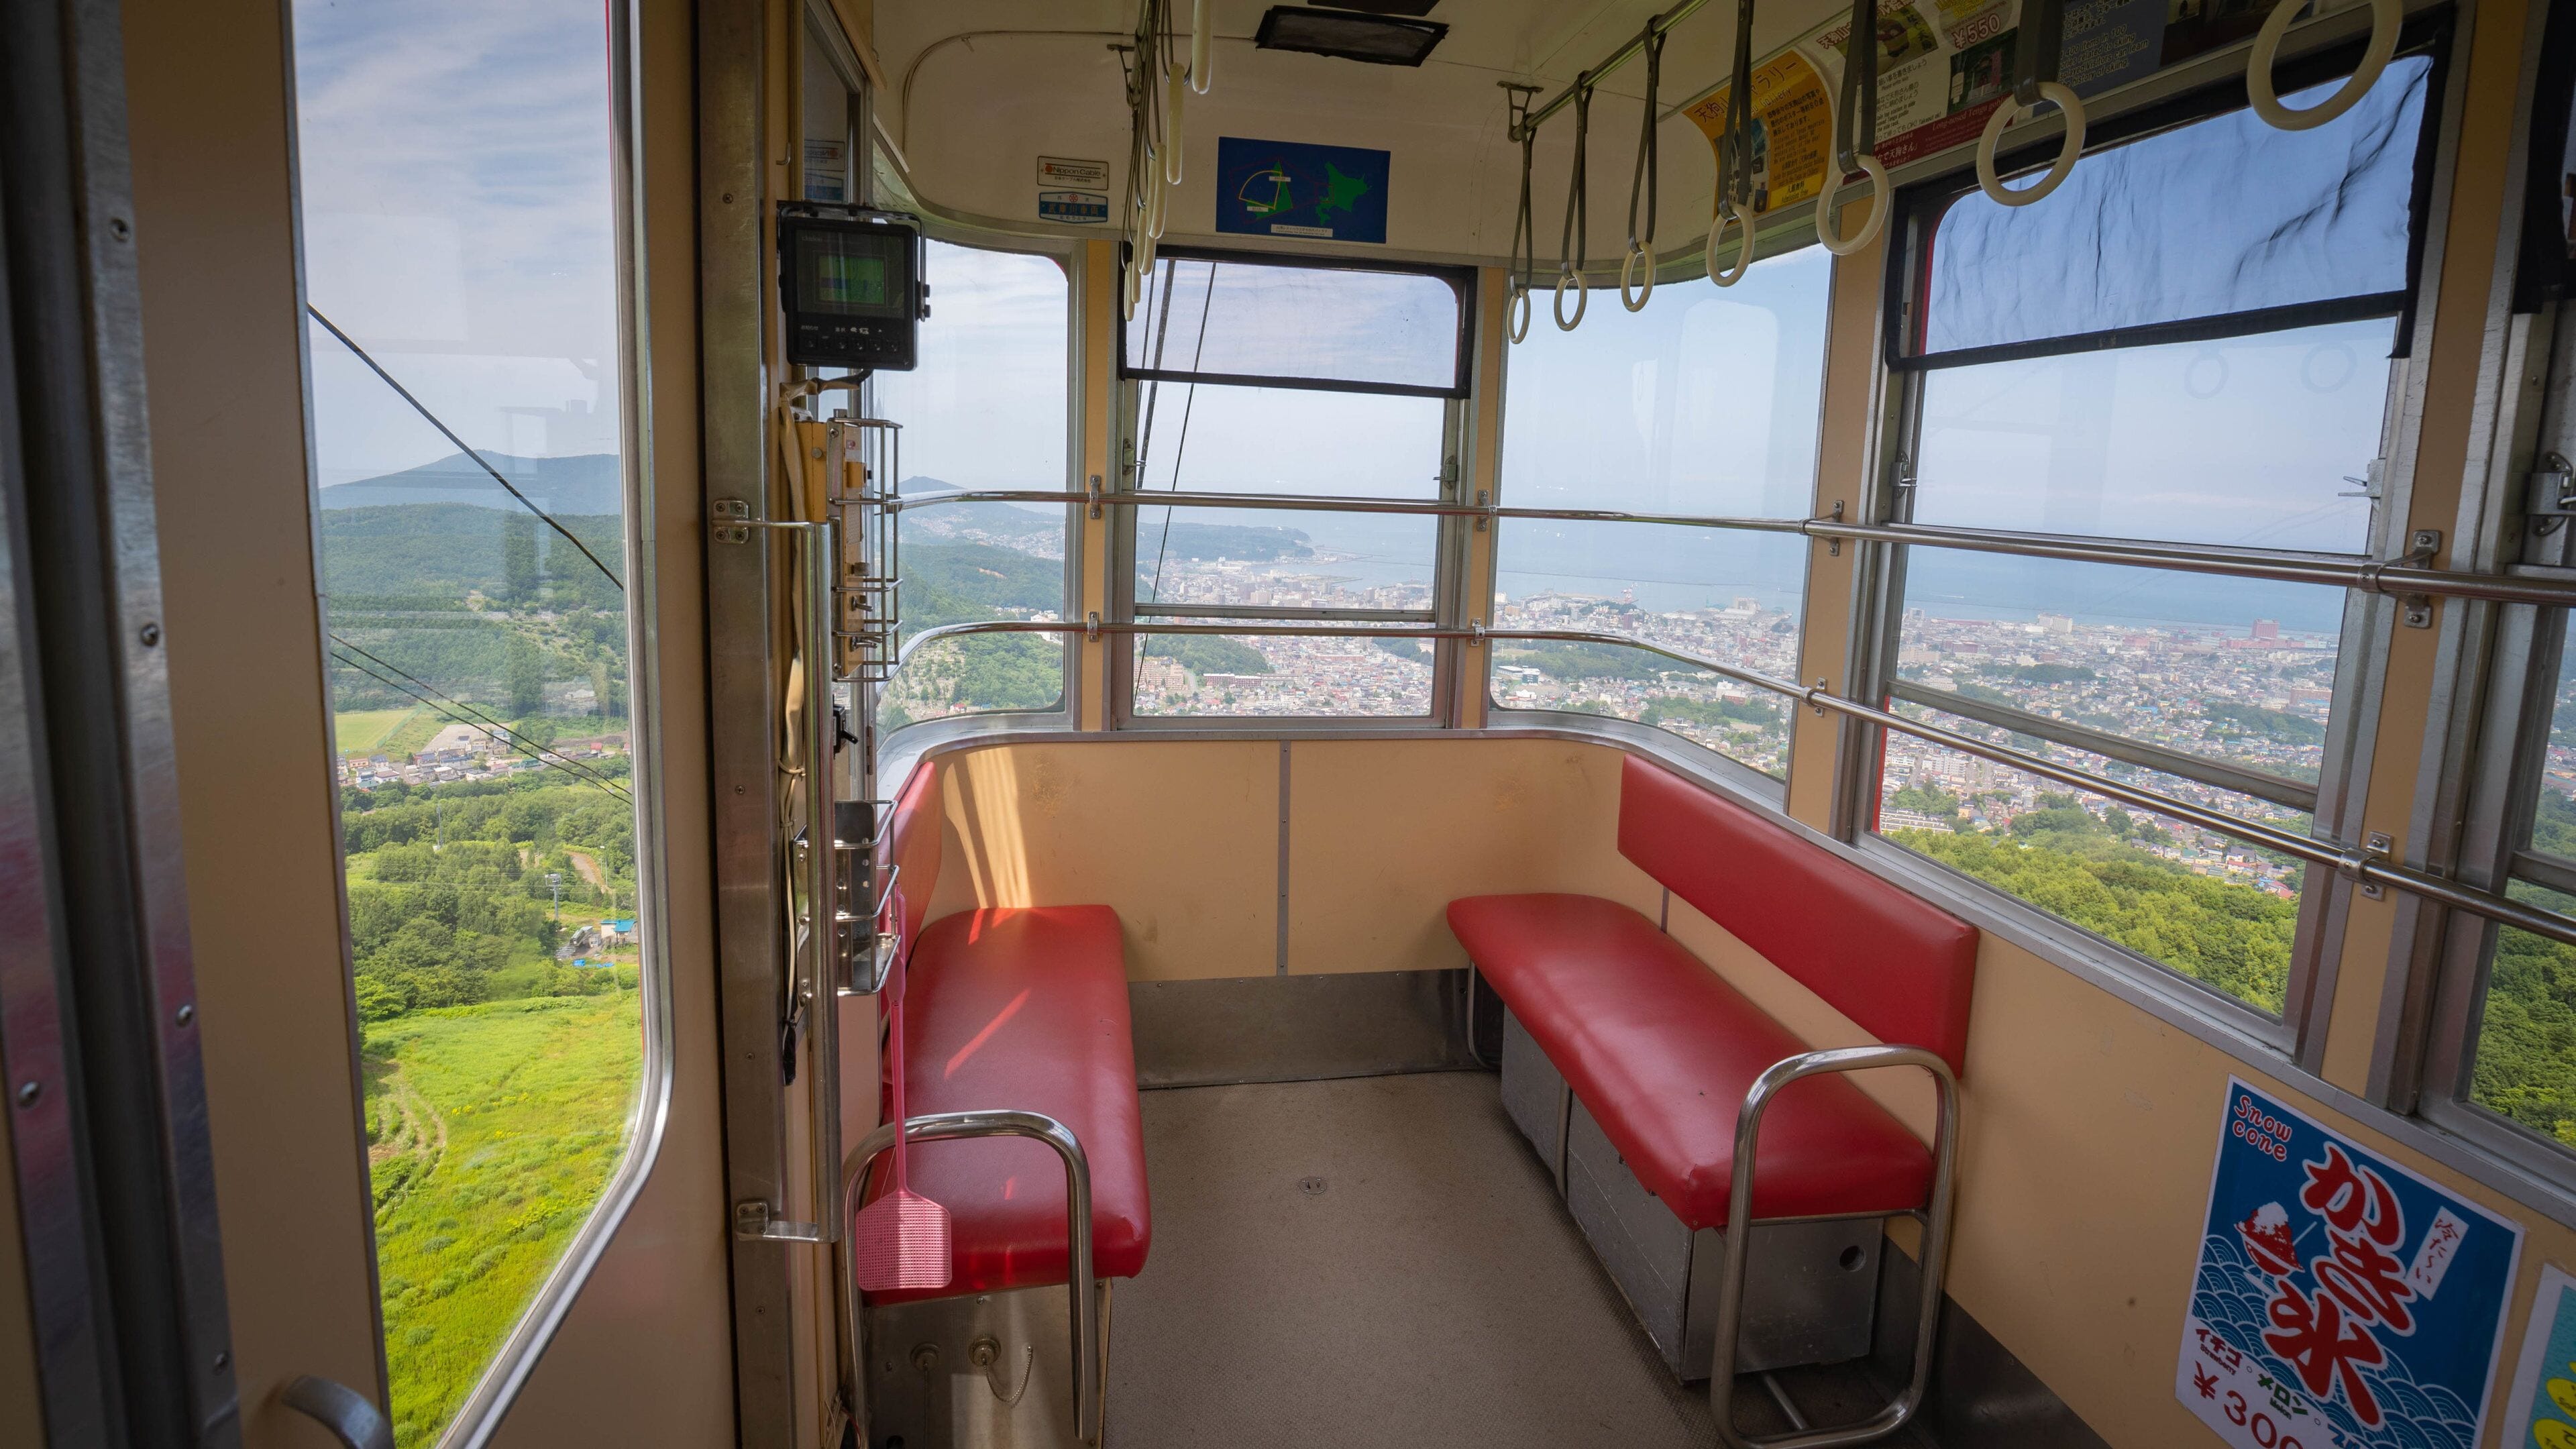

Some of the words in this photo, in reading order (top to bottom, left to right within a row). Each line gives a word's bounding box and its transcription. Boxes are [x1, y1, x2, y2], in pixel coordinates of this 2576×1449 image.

[1951, 13, 2000, 50] ¥550
[1053, 166, 1079, 176] Nippon
[1079, 168, 1101, 176] Cable
[2233, 1095, 2293, 1142] Snow
[2232, 1120, 2288, 1162] cone
[2196, 1328, 2243, 1368] イチゴ
[2200, 1344, 2237, 1376] Strawberry
[2257, 1373, 2309, 1416] メロン
[2269, 1397, 2293, 1421] Melon
